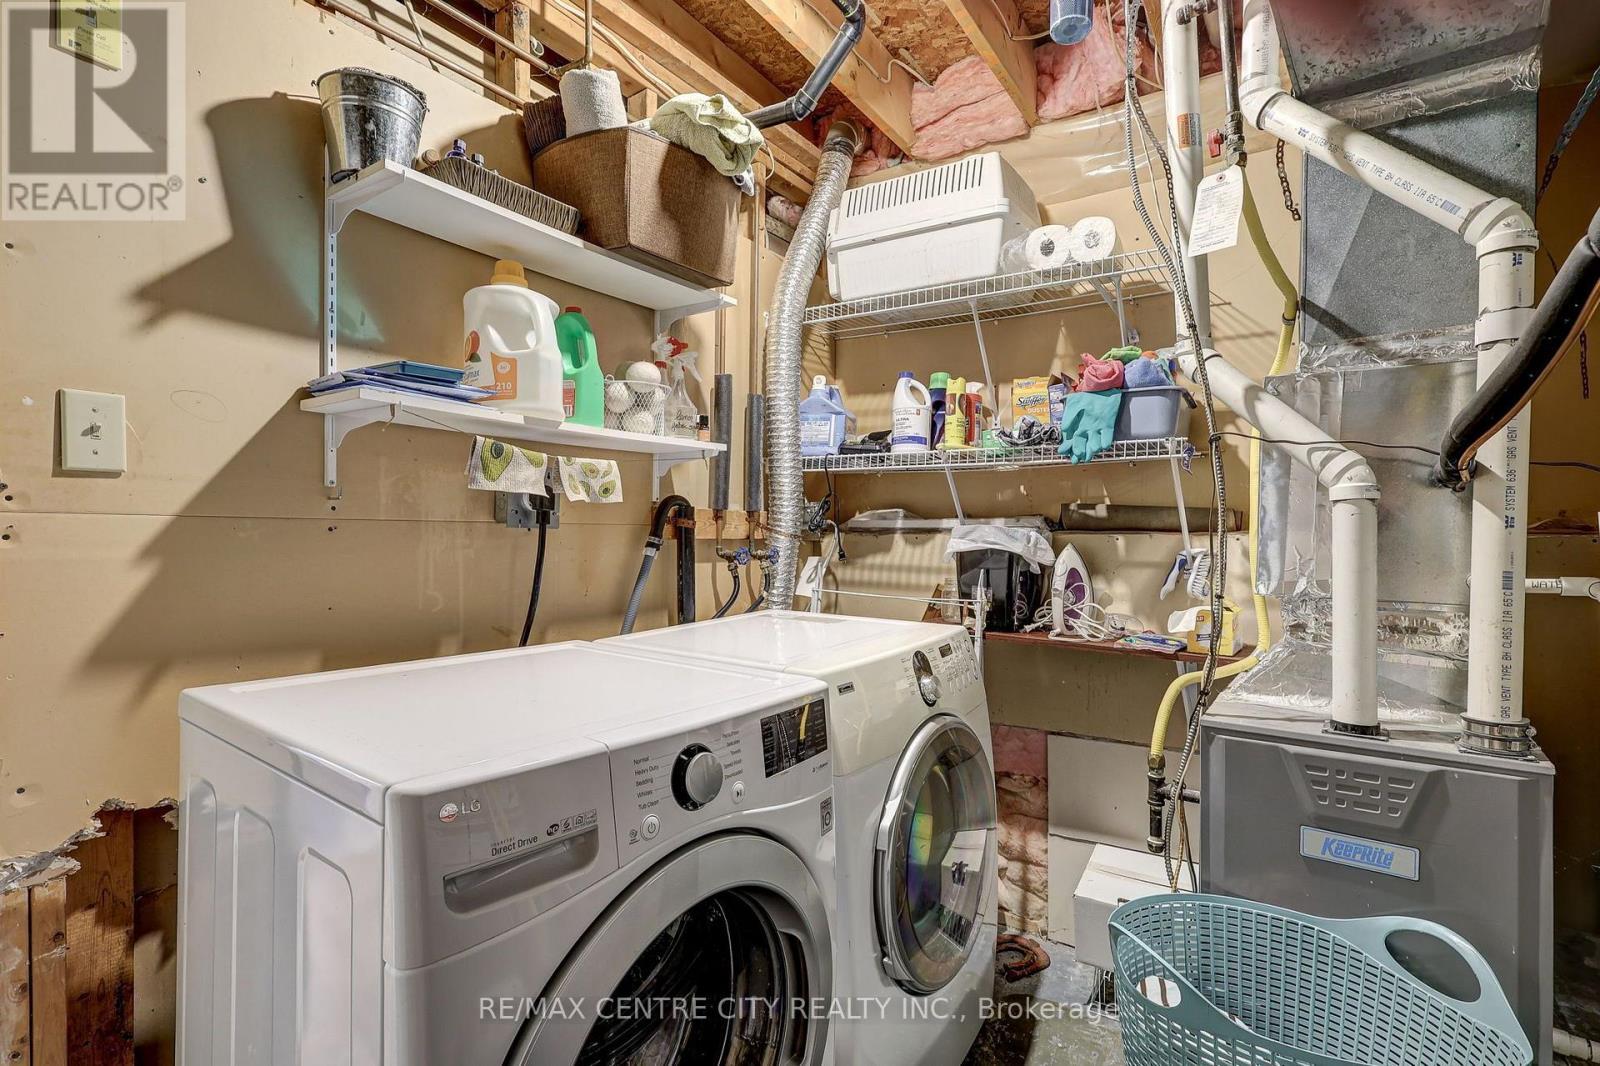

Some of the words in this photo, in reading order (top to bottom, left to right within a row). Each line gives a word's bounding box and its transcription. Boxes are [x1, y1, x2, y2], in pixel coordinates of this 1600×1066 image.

[1370, 164, 1386, 177] TYPE
[1394, 177, 1414, 192] CLASS
[496, 382, 512, 390] 210
[1506, 426, 1518, 442] VENT
[1506, 446, 1517, 459] GAS
[1505, 469, 1517, 482] 636
[1505, 485, 1516, 511] SYSTEM
[1502, 627, 1513, 649] CLASS
[1502, 652, 1512, 661] BH
[1501, 664, 1512, 681] TYPE
[1501, 686, 1511, 702] VENT
[1500, 706, 1511, 719] GAS
[461, 800, 481, 814] LG
[491, 842, 517, 857] Direct
[517, 835, 539, 848] Drive
